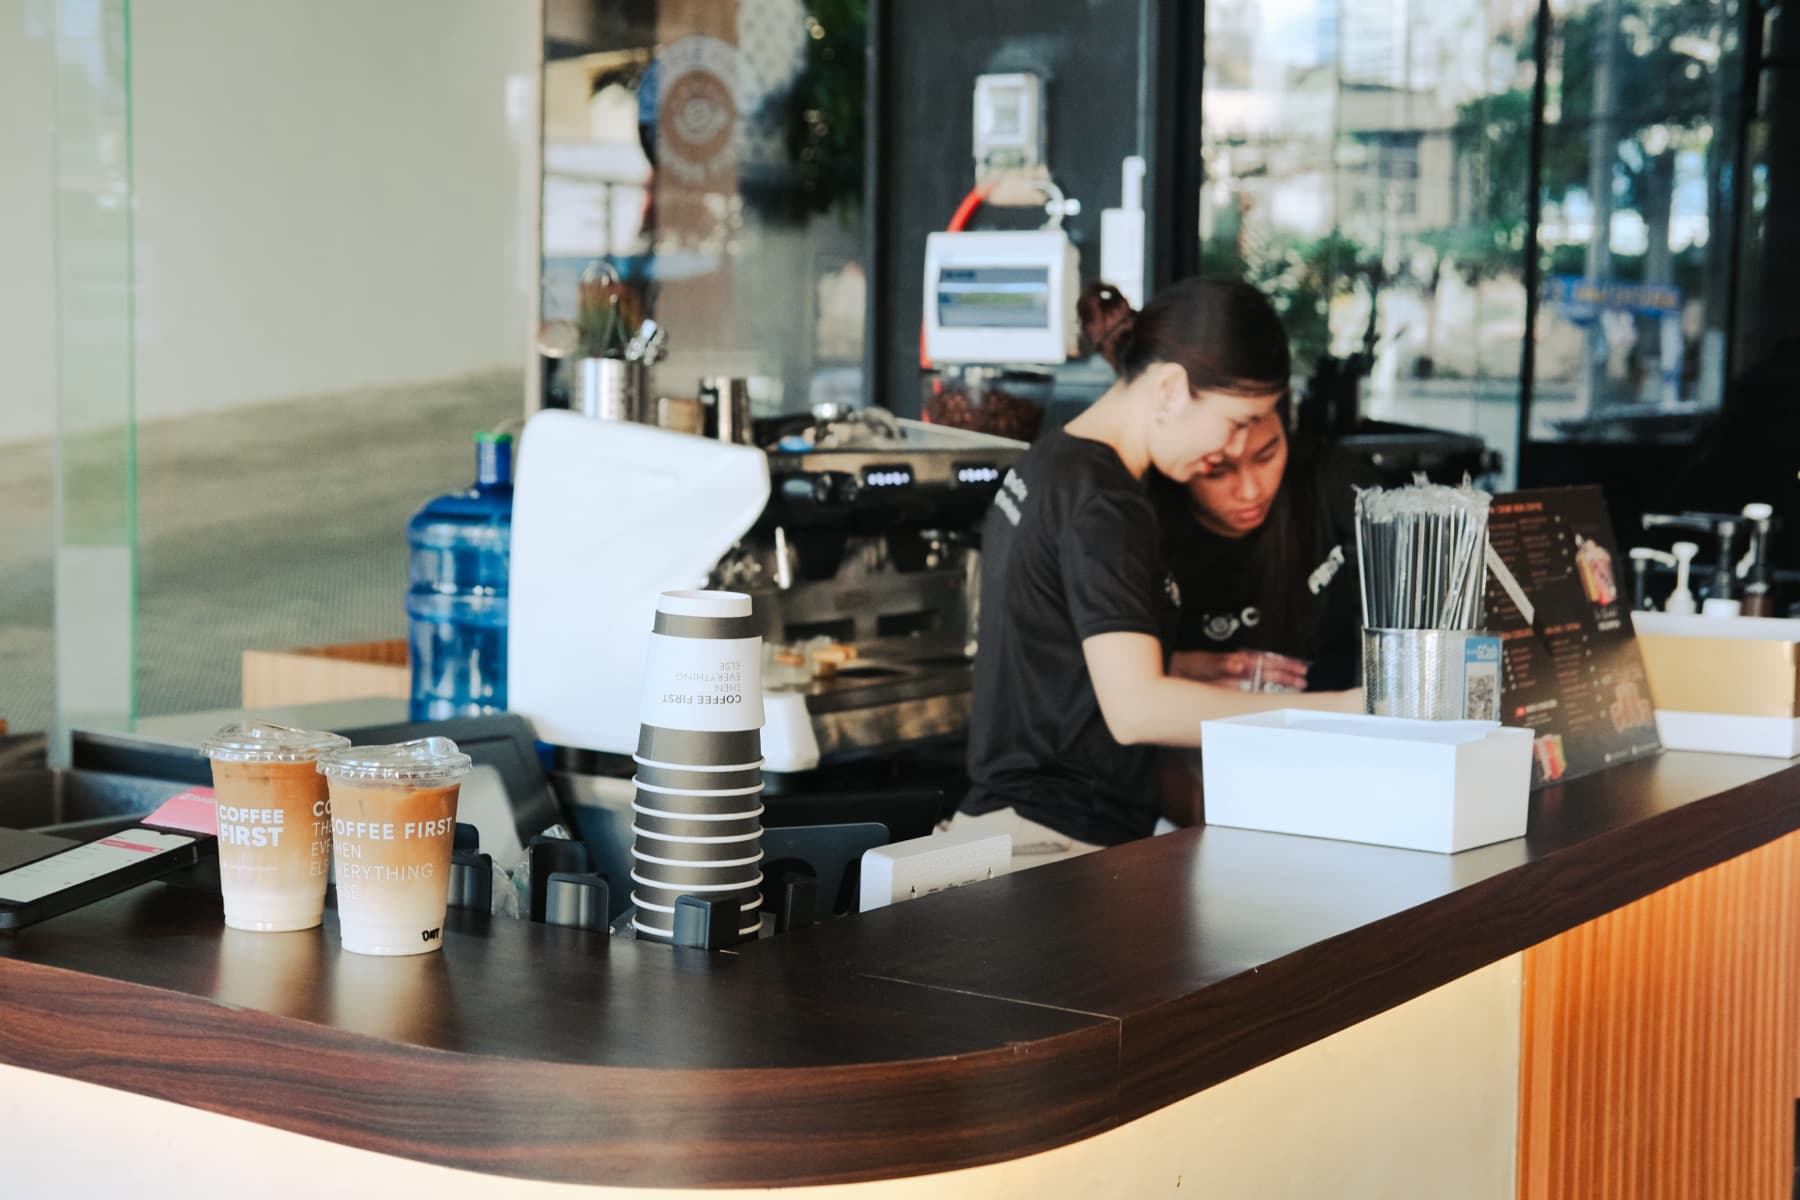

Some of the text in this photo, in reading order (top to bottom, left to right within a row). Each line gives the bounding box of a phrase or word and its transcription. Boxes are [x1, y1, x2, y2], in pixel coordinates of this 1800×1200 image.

[720, 661, 741, 671] ELSE
[675, 671, 741, 682] EVERYTHING
[715, 683, 741, 693] THEN
[662, 693, 742, 705] COFFEE FIRST
[218, 804, 284, 824] COFFEE
[219, 822, 284, 848] FIRST
[404, 816, 453, 840] FIRST
[334, 839, 361, 859] HEN
[337, 862, 433, 881] VERYTHING
